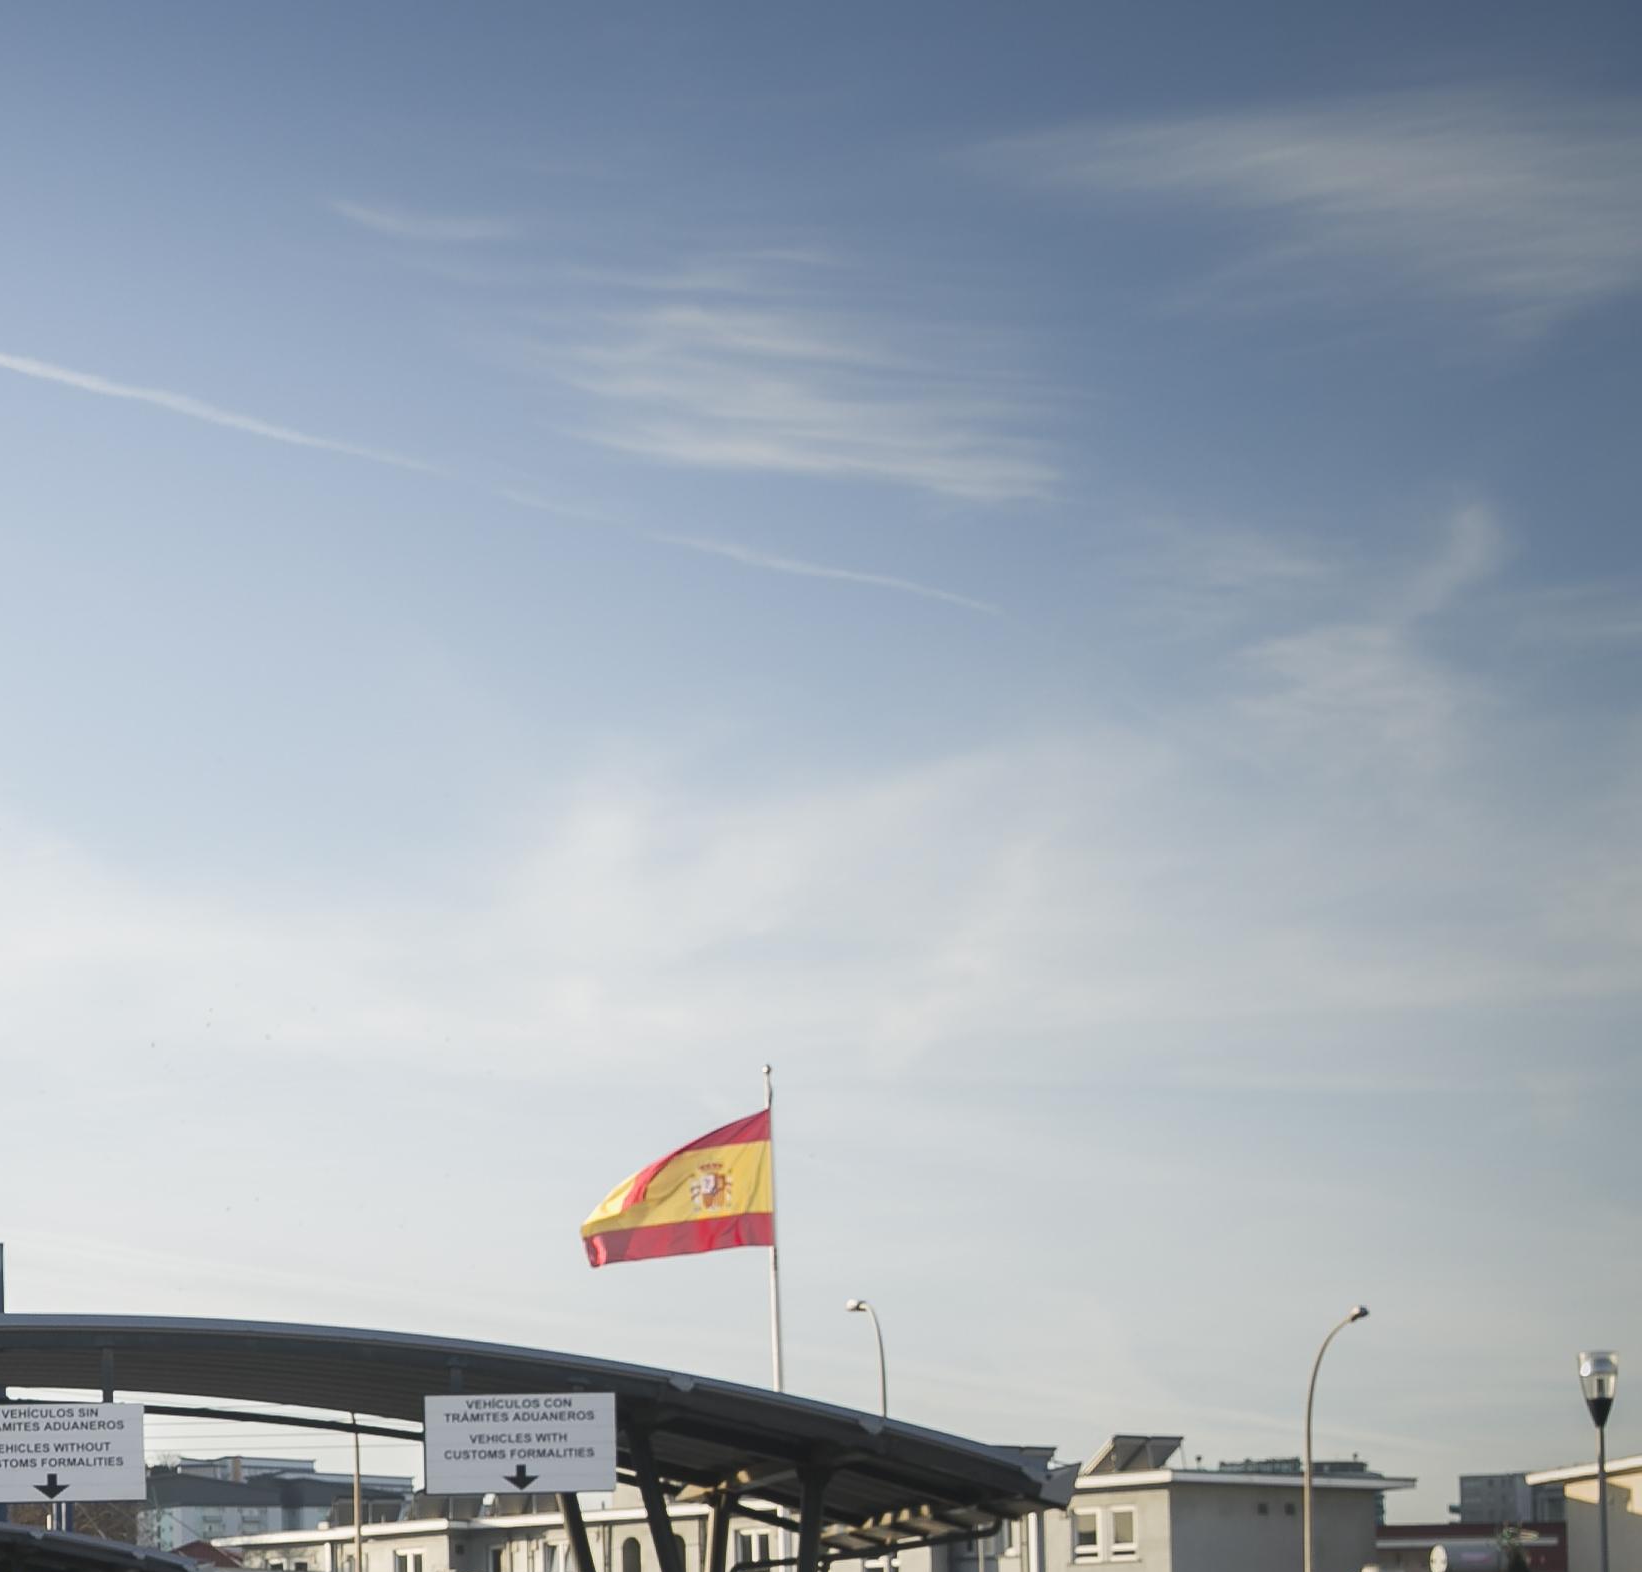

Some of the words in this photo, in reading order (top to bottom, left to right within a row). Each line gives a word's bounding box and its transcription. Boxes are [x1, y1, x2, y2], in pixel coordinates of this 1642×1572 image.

[466, 1397, 540, 1409] VEHÍCULOS
[544, 1398, 572, 1408] CON
[1, 1407, 75, 1419] VEHÍCULOS
[78, 1408, 99, 1418] SIN
[444, 1411, 508, 1422] TRÁMITES
[512, 1410, 595, 1421] ADUANEROS
[44, 1420, 125, 1431] ADUANEROS
[470, 1433, 532, 1444] VEHICLES
[535, 1432, 568, 1442] WITH
[53, 1441, 111, 1452] WITHOUT
[444, 1449, 506, 1460] CUSTOMS
[510, 1447, 595, 1458] FORMALITIES
[41, 1456, 124, 1467] FORMALITIES
